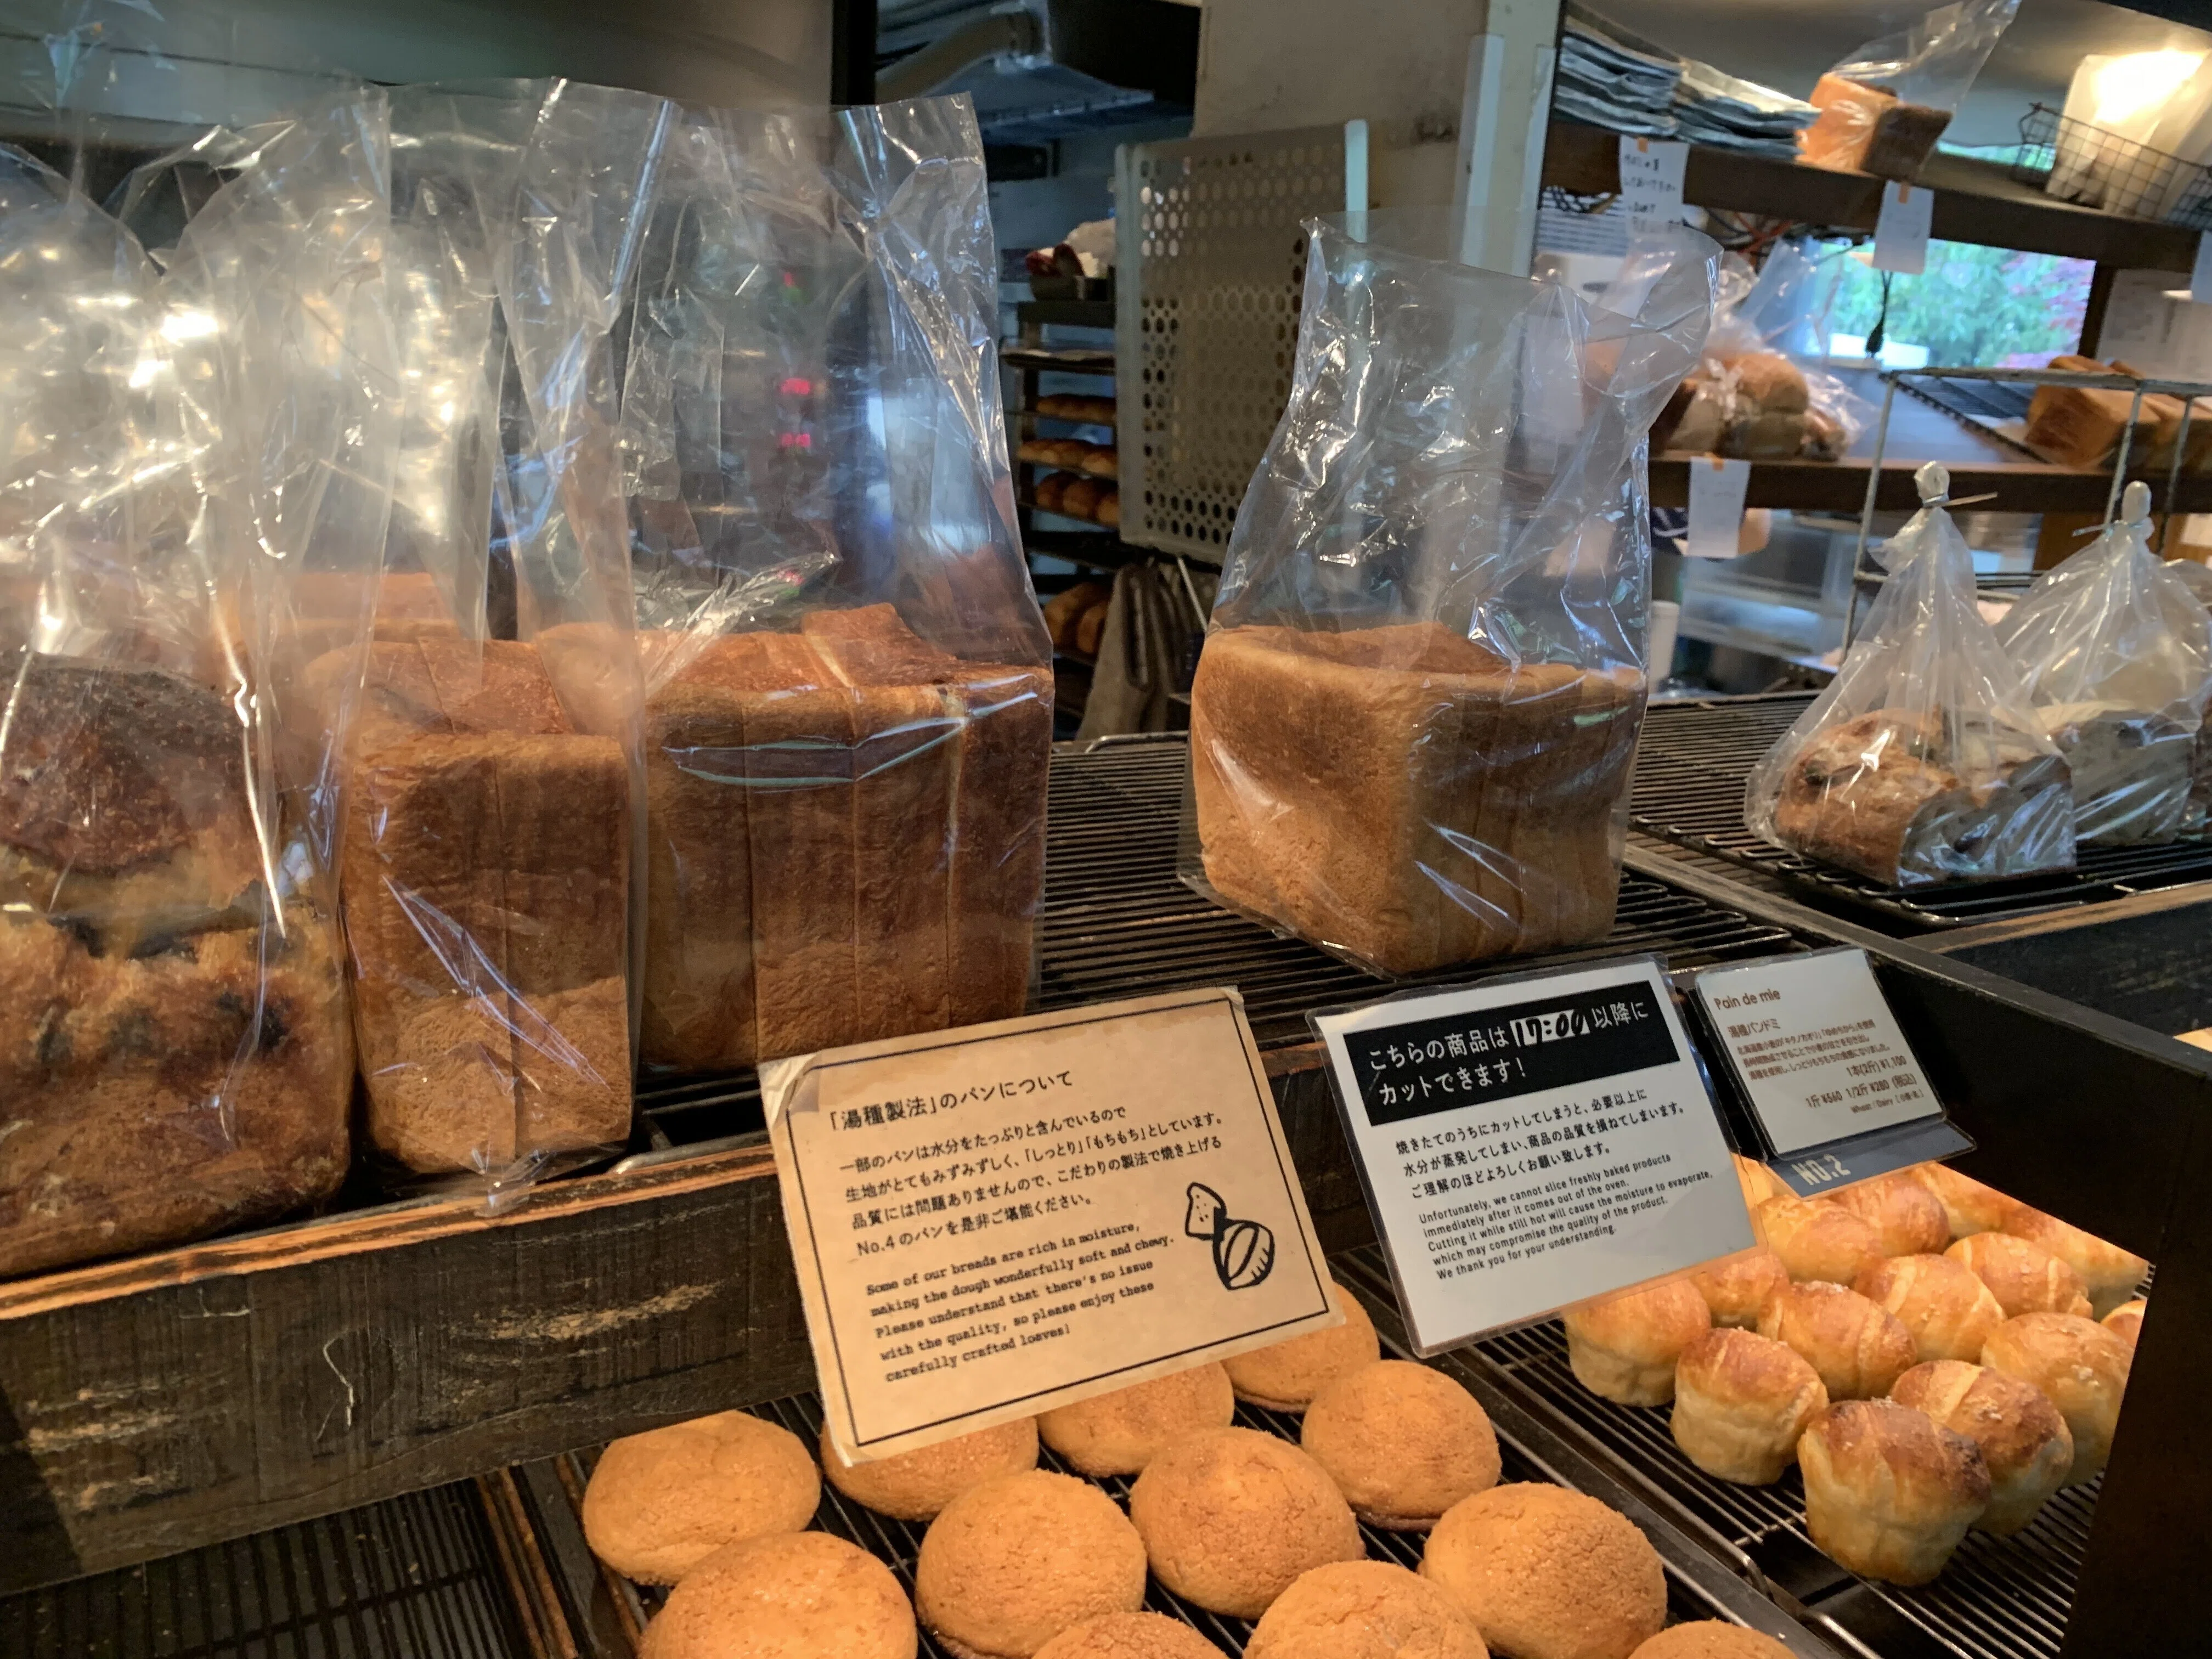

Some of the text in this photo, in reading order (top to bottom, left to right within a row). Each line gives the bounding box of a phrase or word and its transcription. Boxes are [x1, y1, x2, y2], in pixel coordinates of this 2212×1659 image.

[1713, 988, 1781, 1011] Pain de mie
[1370, 1026, 1509, 1070] こちらの商品は
[1591, 1002, 1647, 1028] 以降に
[830, 1070, 1073, 1130] 「湯種製法」のパンについて
[1379, 1057, 1525, 1105] カットできます！
[1820, 1090, 1843, 1104] ¥560
[1418, 1154, 1671, 1224] Unfortunately, we cannot slice freshly baked products
[1791, 1154, 1852, 1186] NO.2
[1423, 1179, 1629, 1238] immediately after it comes out of the oven.
[1427, 1171, 1713, 1252] Cutting it while still hot will cause the moisture to evaporate,
[1432, 1195, 1667, 1266] which may compromise the quality of the product.
[866, 1223, 1139, 1296] Some of our breads are rich in moisture,
[870, 1235, 1174, 1317] making the dough wonderfully soft and chewy.
[1436, 1268, 1453, 1280] We
[1455, 1259, 1485, 1276] thank
[1487, 1255, 1505, 1269] you
[1506, 1250, 1521, 1260] for
[1524, 1243, 1545, 1259] your
[874, 1261, 1153, 1339] Please understand that there's no issue
[879, 1282, 1154, 1361] with the quality, so please enjoy these
[885, 1355, 957, 1383] carefully
[961, 1336, 1017, 1362] crafted
